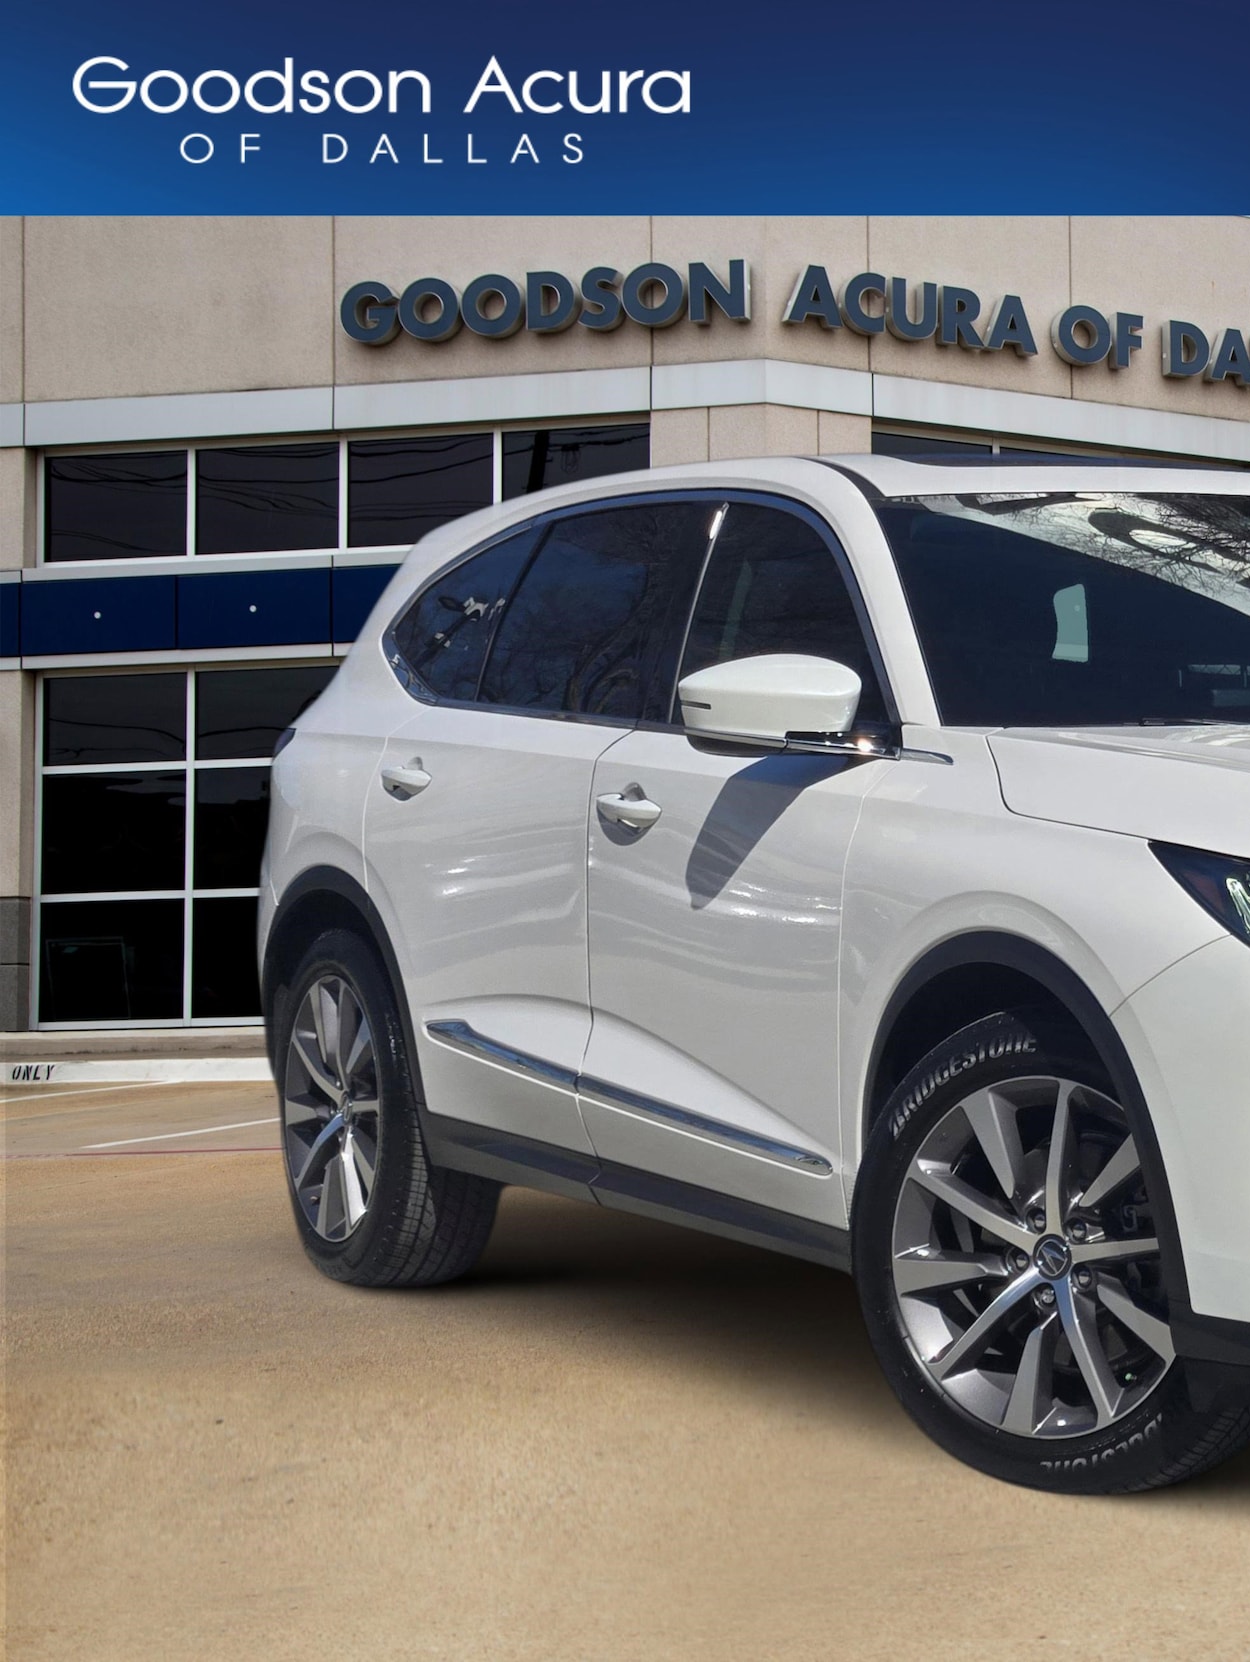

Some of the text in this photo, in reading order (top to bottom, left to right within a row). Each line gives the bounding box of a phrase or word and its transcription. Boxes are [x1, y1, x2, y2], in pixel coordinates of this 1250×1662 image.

[340, 259, 751, 347] GOODSON
[782, 264, 1038, 358] ACURA
[1051, 304, 1144, 371] OF
[12, 1065, 55, 1080] ONLY
